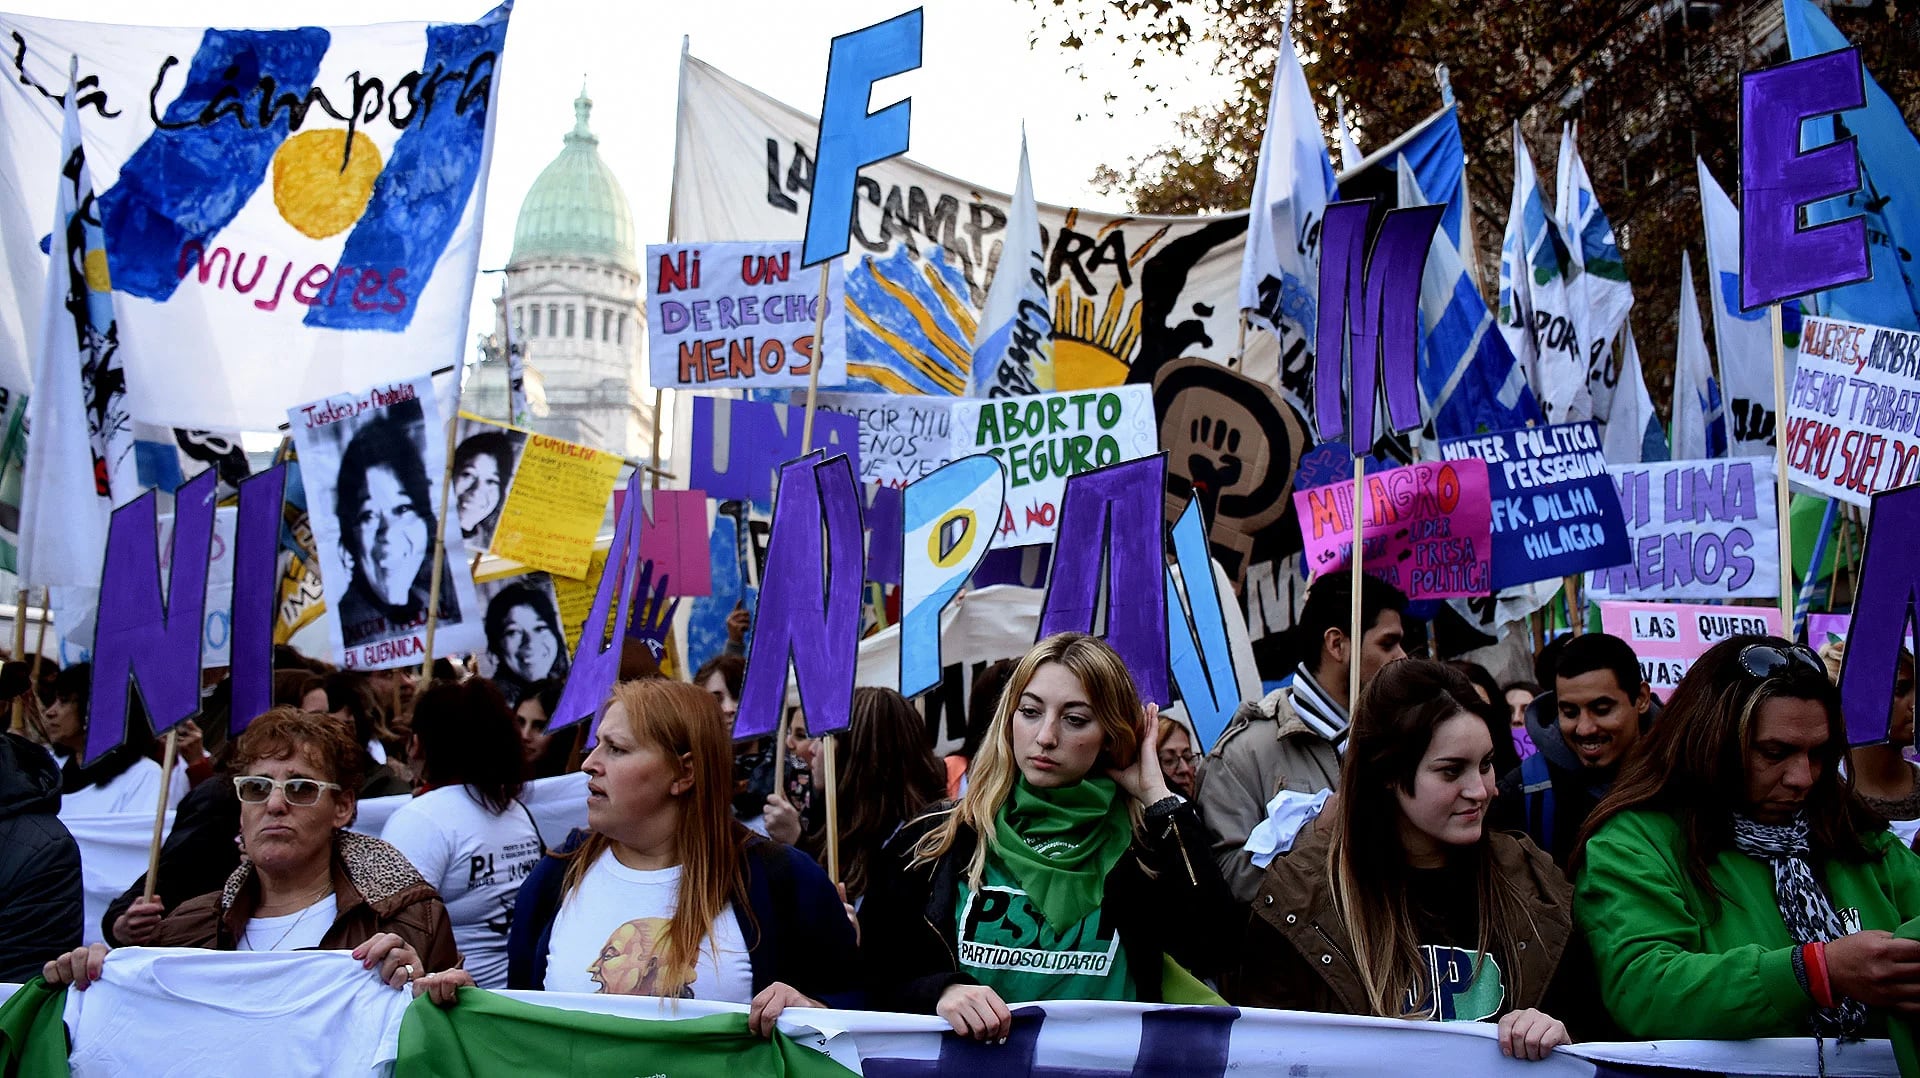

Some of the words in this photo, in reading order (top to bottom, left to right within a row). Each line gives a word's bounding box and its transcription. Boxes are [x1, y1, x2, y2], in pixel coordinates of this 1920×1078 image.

[800, 5, 923, 270] F
[1739, 43, 1873, 313] E
[657, 250, 701, 294] Ni
[741, 251, 791, 286] UN
[660, 295, 832, 335] DERECHO
[677, 335, 824, 384] MENOS
[976, 393, 1122, 446] ABORTO
[1515, 424, 1598, 459] POLITICA
[1664, 463, 1757, 524] UNA
[1416, 537, 1476, 566] PRESA
[1523, 523, 1605, 560] MILAGRO
[1411, 561, 1490, 595] POLITICA
[1635, 616, 1676, 638] LAS
[961, 942, 1108, 971] PARTIDOSOLIDARIO
